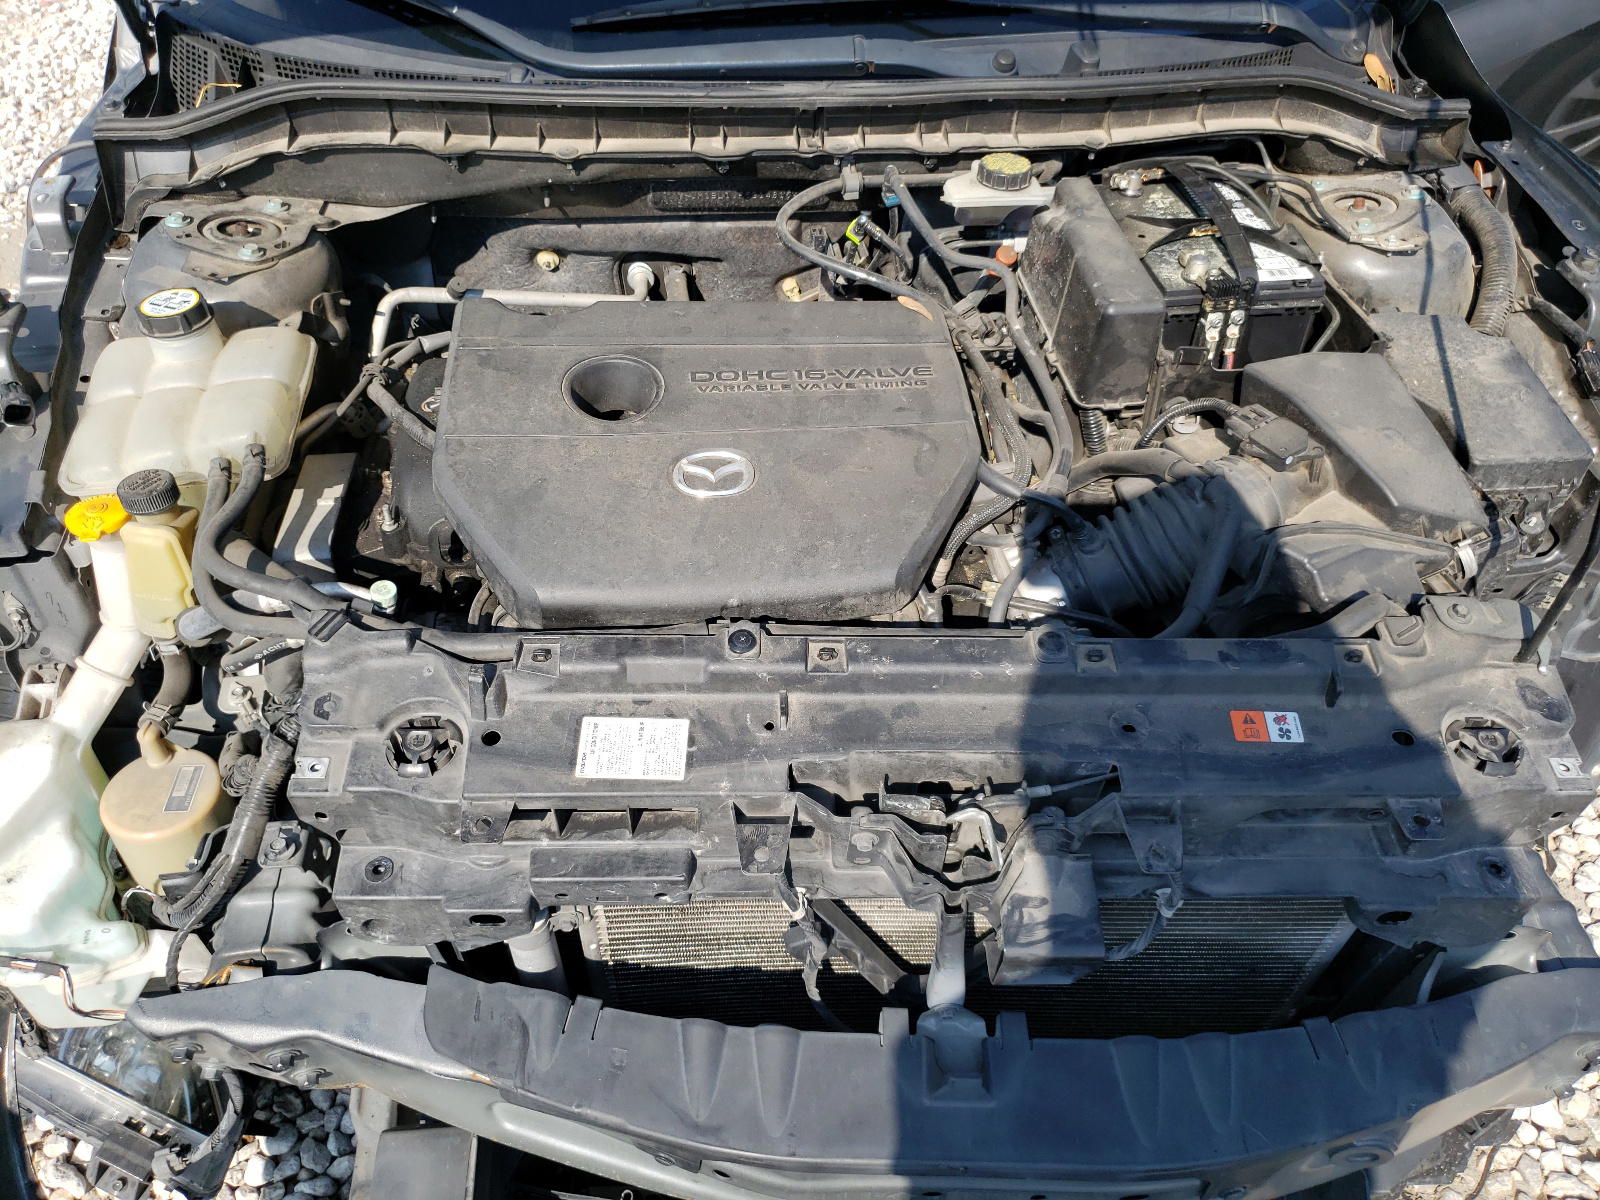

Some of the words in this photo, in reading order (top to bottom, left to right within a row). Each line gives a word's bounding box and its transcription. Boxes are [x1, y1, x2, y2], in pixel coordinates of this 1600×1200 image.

[690, 369, 788, 383] DOHC
[795, 366, 934, 381] 16-VALVE
[696, 383, 793, 394] VARIABLE
[798, 382, 857, 391] VALVE
[863, 379, 928, 389] TIMING
